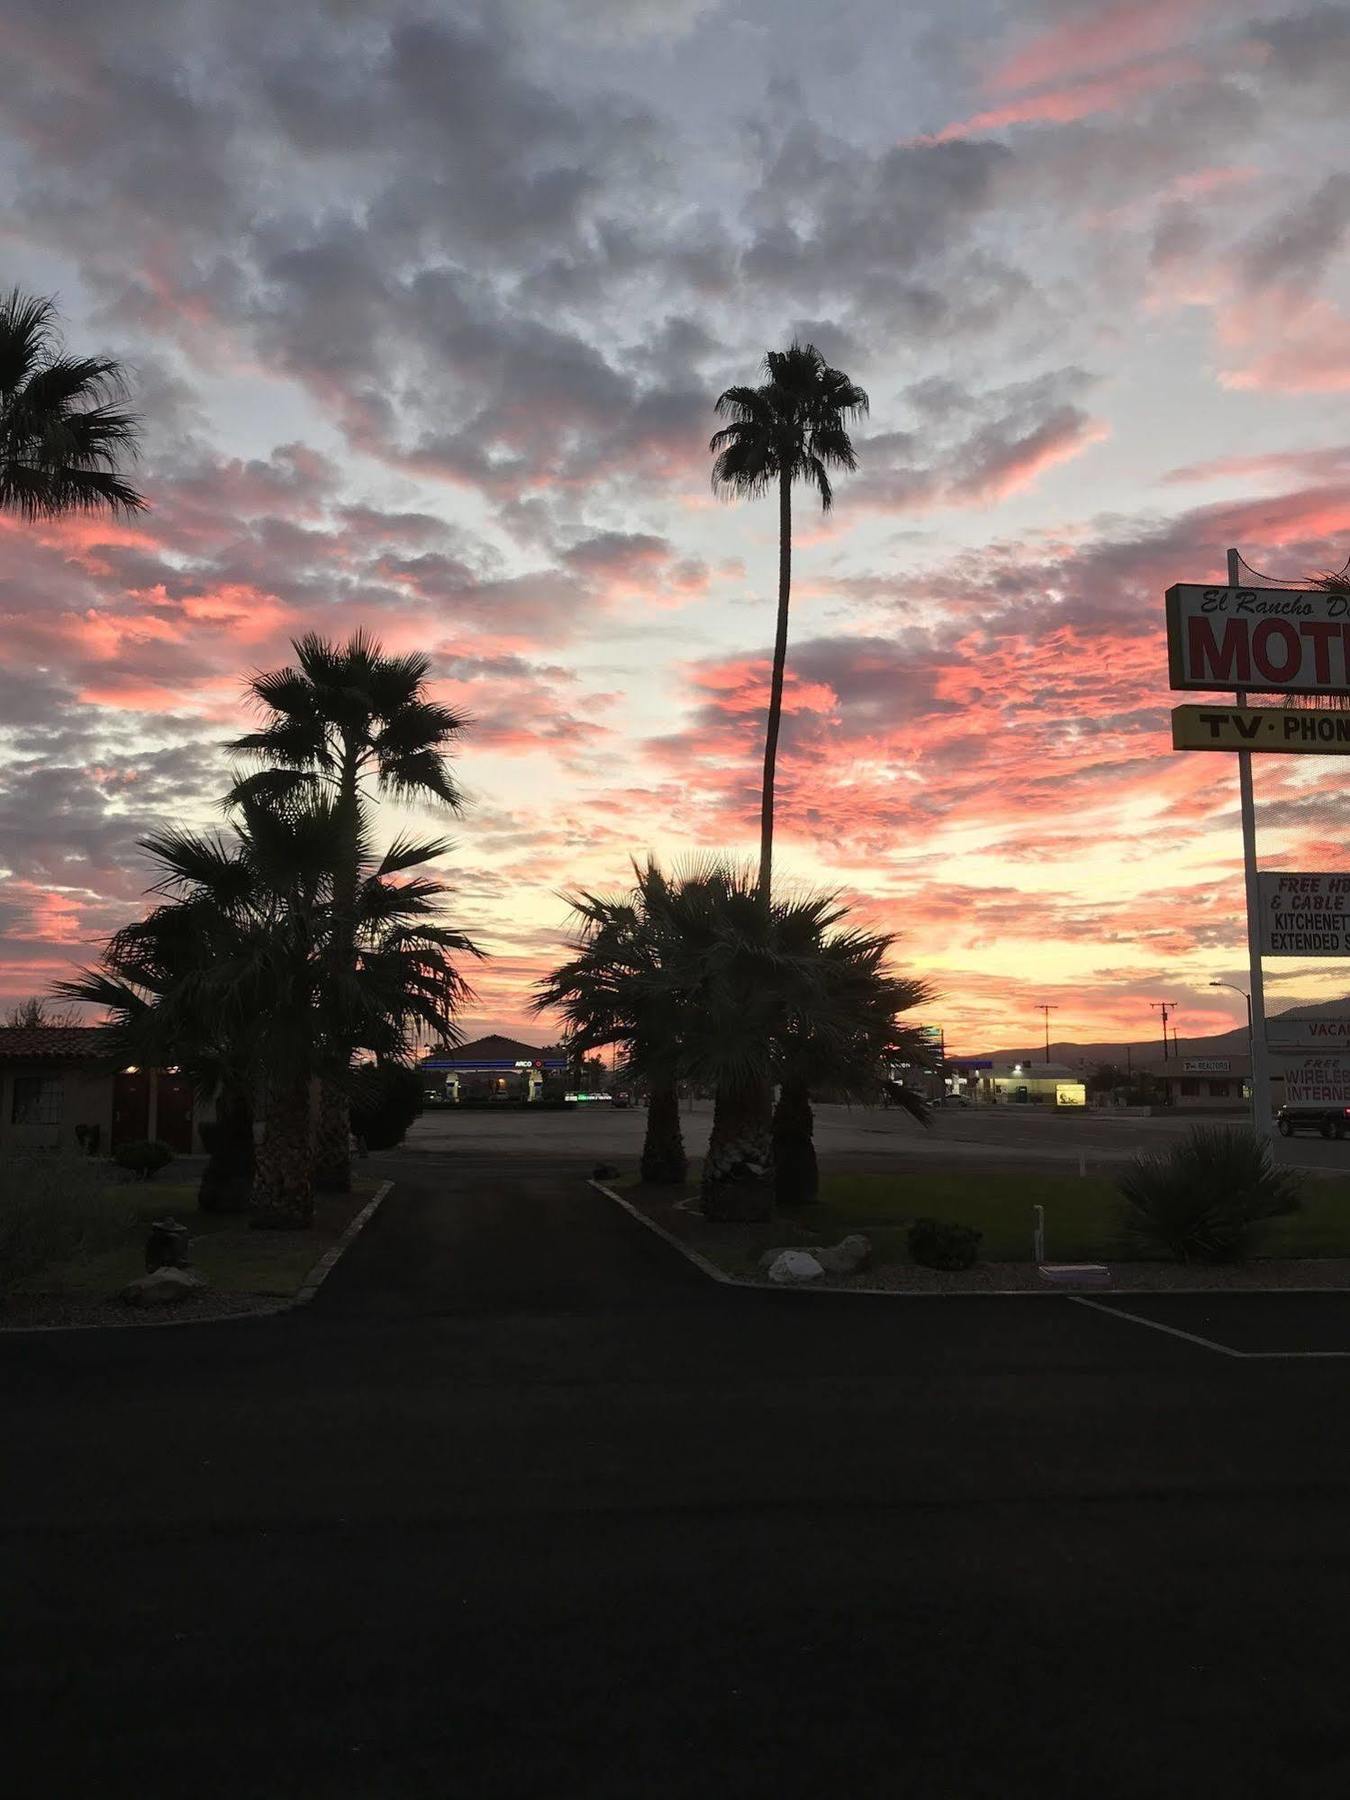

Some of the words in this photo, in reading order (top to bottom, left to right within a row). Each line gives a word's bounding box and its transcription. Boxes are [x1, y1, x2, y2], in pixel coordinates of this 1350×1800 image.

[1201, 590, 1228, 613] El
[1235, 591, 1314, 615] Rancho
[1326, 595, 1350, 617] D
[1188, 616, 1350, 684] MOT
[1199, 714, 1263, 739] TV
[1278, 877, 1321, 894] FREE
[1270, 895, 1281, 910] &
[1292, 895, 1344, 911] CABLE
[1274, 913, 1350, 931] KITCHENET
[1270, 933, 1339, 951] EXTENDED
[1308, 1023, 1350, 1036] VACA
[515, 1060, 533, 1068] ARCO
[1304, 1059, 1341, 1068] FREE
